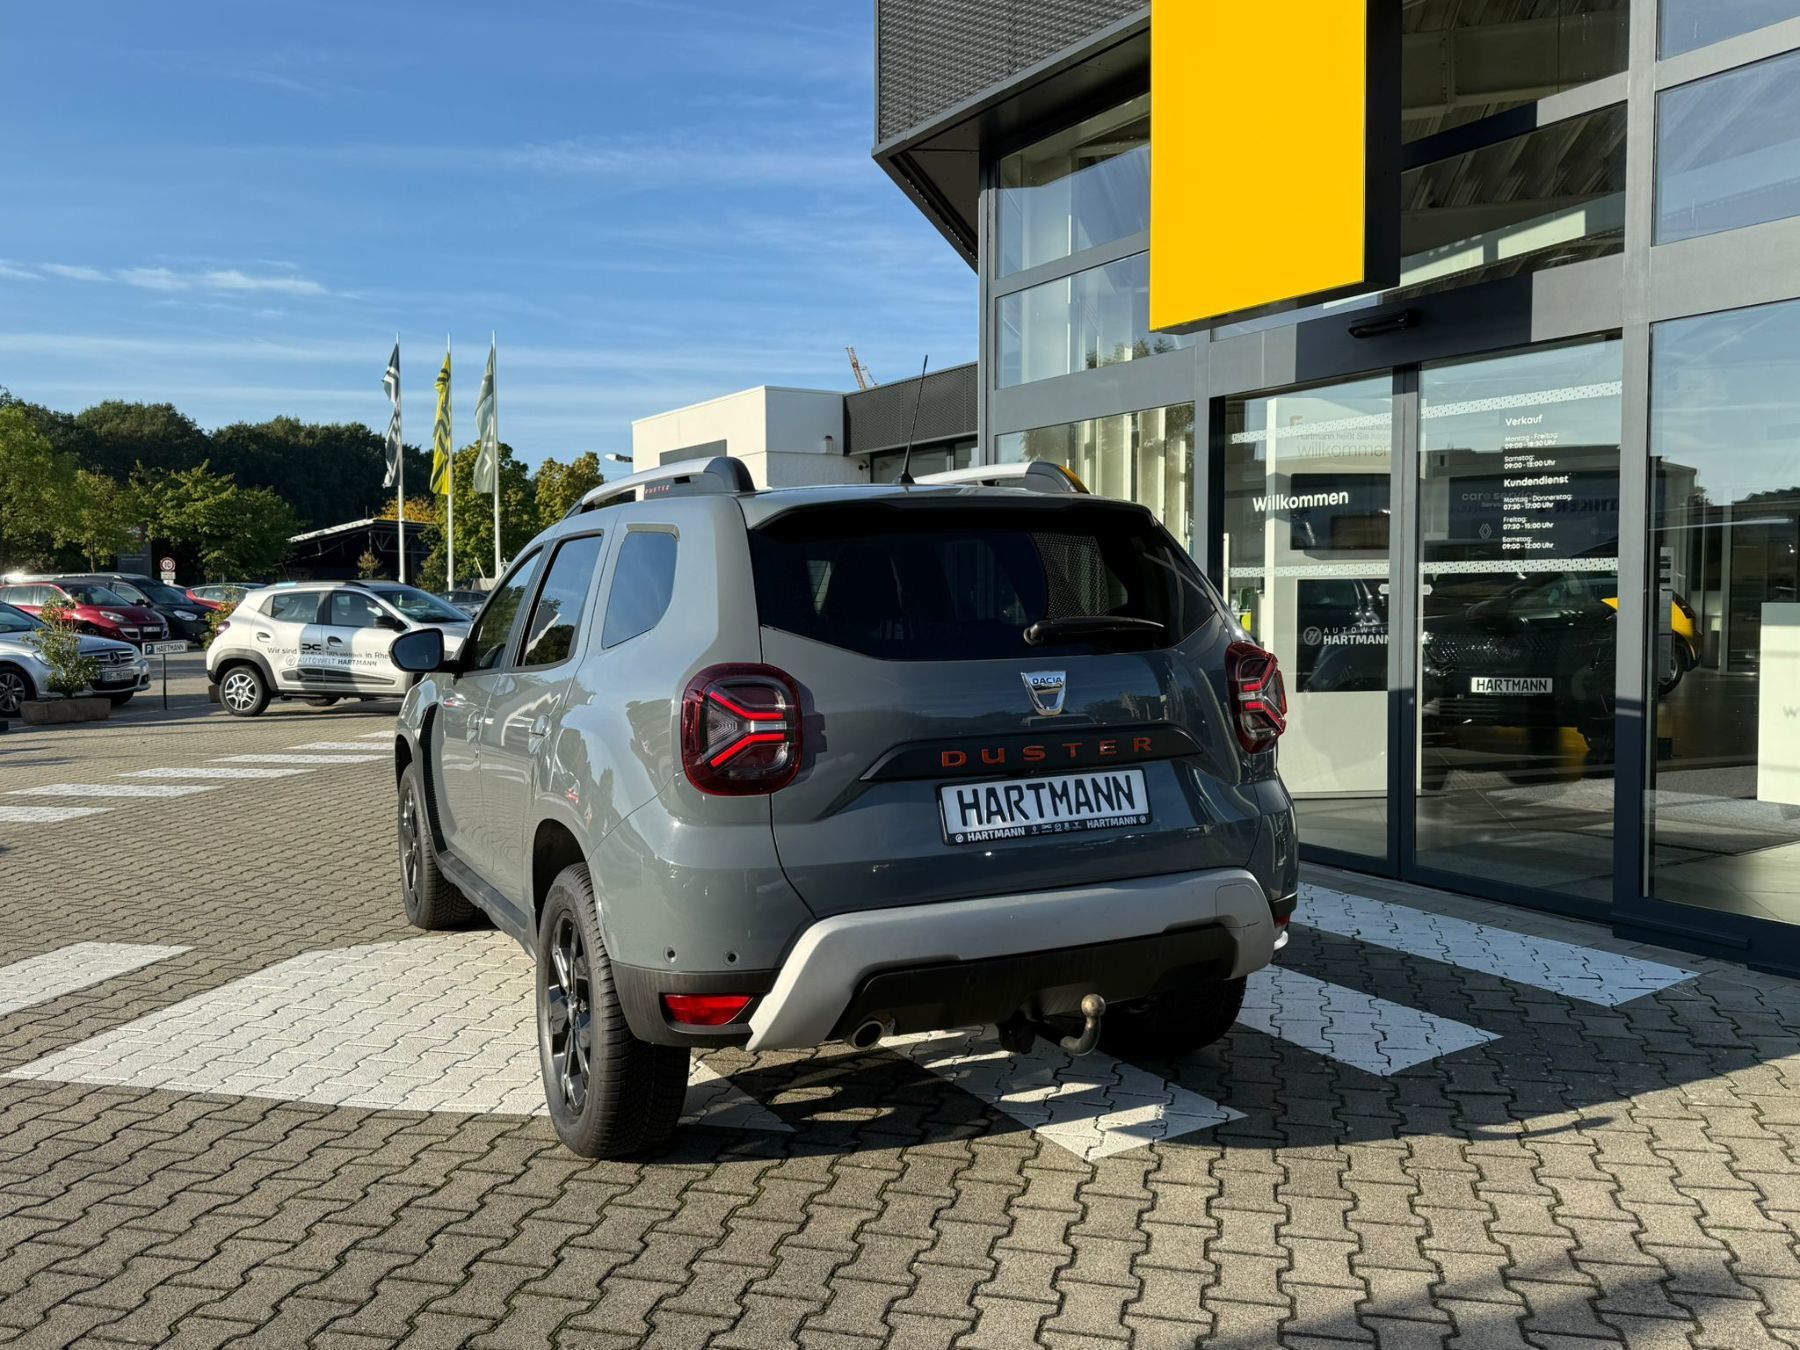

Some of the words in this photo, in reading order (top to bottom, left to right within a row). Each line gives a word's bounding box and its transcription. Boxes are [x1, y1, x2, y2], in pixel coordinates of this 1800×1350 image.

[1505, 414, 1543, 426] Verkauf
[1505, 435, 1529, 444] Montag
[1503, 475, 1569, 487] Kundendienst
[1252, 491, 1349, 512] Willkommen
[1504, 496, 1528, 504] Montag
[1323, 626, 1385, 634] AUTOWEL
[374, 652, 390, 660] Rhe
[338, 659, 377, 667] HARTMANN
[1032, 676, 1063, 684] DACIA
[1476, 679, 1547, 692] HARTMANN
[941, 737, 1152, 767] DUSTER
[957, 775, 1135, 827] HARTMANN
[967, 827, 1026, 842] HARTMANN
[1086, 816, 1137, 830] HARTMANN
